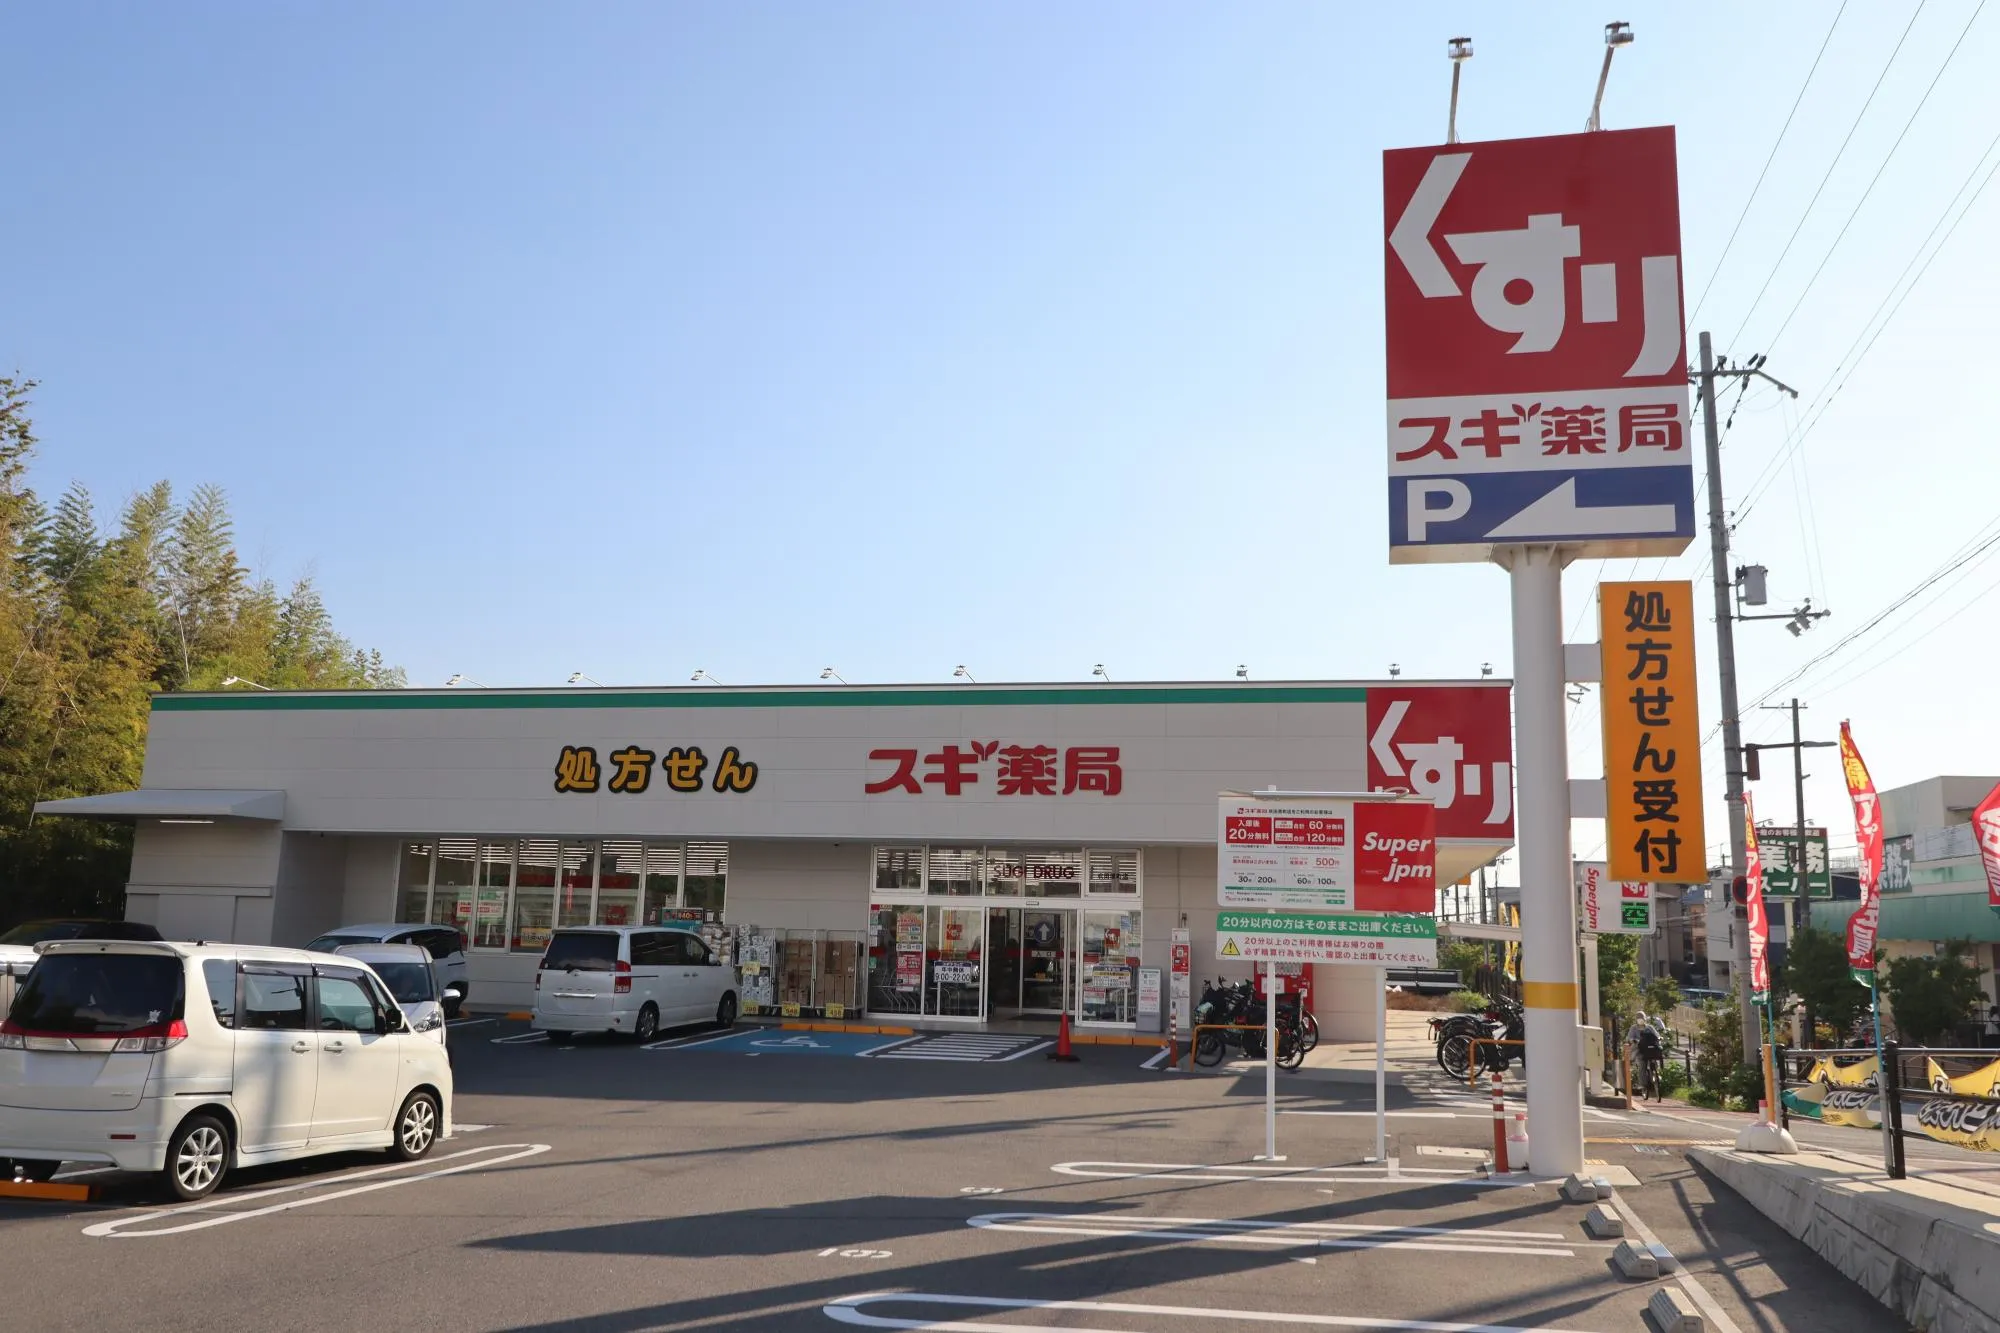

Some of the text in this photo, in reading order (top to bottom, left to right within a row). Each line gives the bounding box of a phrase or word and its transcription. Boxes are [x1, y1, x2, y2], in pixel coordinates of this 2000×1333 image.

[1388, 152, 1682, 378] くすり
[1395, 402, 1683, 462] スギ薬局
[1406, 478, 1472, 541] P
[1624, 590, 1682, 874] 処方せん受付
[554, 745, 759, 793] 処方せん
[865, 740, 1122, 795] スギ薬局
[1369, 700, 1512, 824] くすり
[1229, 828, 1270, 841] 20分無料
[1362, 832, 1432, 857] Super
[1755, 828, 1820, 837] 一般のお客様歓迎
[993, 863, 1075, 880] SUGI DRUG
[1382, 857, 1433, 883] jpm
[1585, 867, 1600, 929] Superjpm
[1222, 916, 1430, 935] 20分以内の方はそのままご出庫ください。
